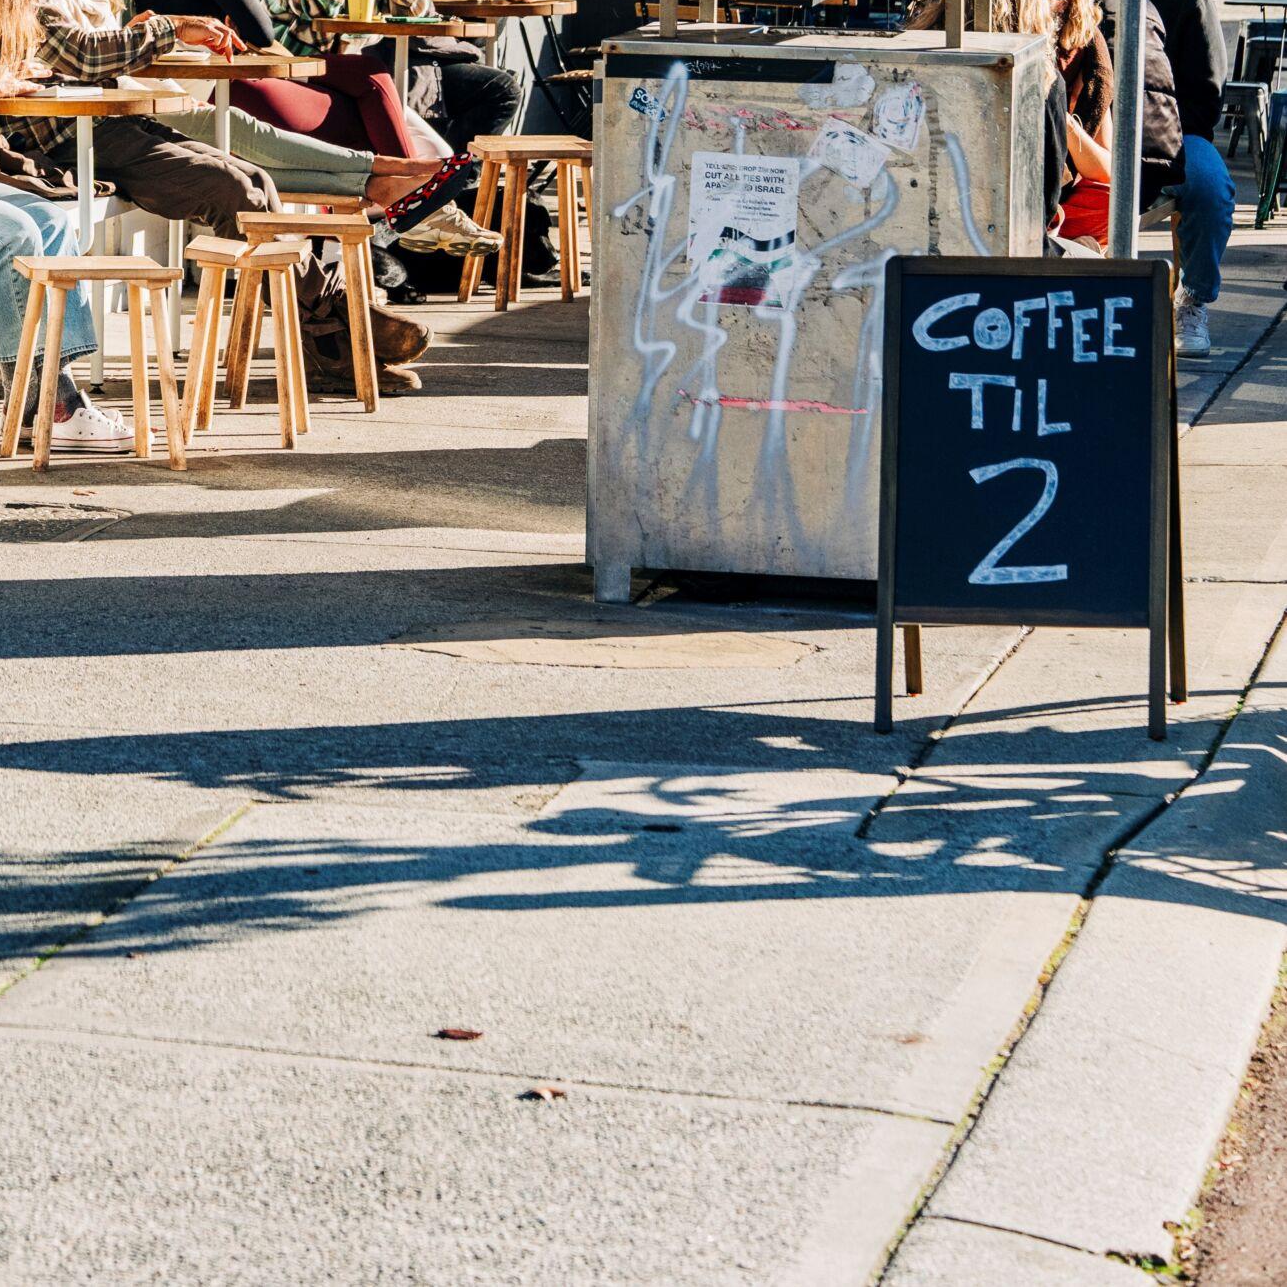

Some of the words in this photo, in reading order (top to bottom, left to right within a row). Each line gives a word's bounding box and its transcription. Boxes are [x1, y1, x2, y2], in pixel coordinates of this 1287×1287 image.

[704, 171, 722, 180] CUT
[724, 173, 740, 181] ALL
[763, 176, 785, 184] WITH
[755, 185, 786, 195] ISRAEL
[912, 290, 1136, 362] COFFEE
[949, 372, 1072, 437] TIL
[968, 457, 1068, 585] 2
